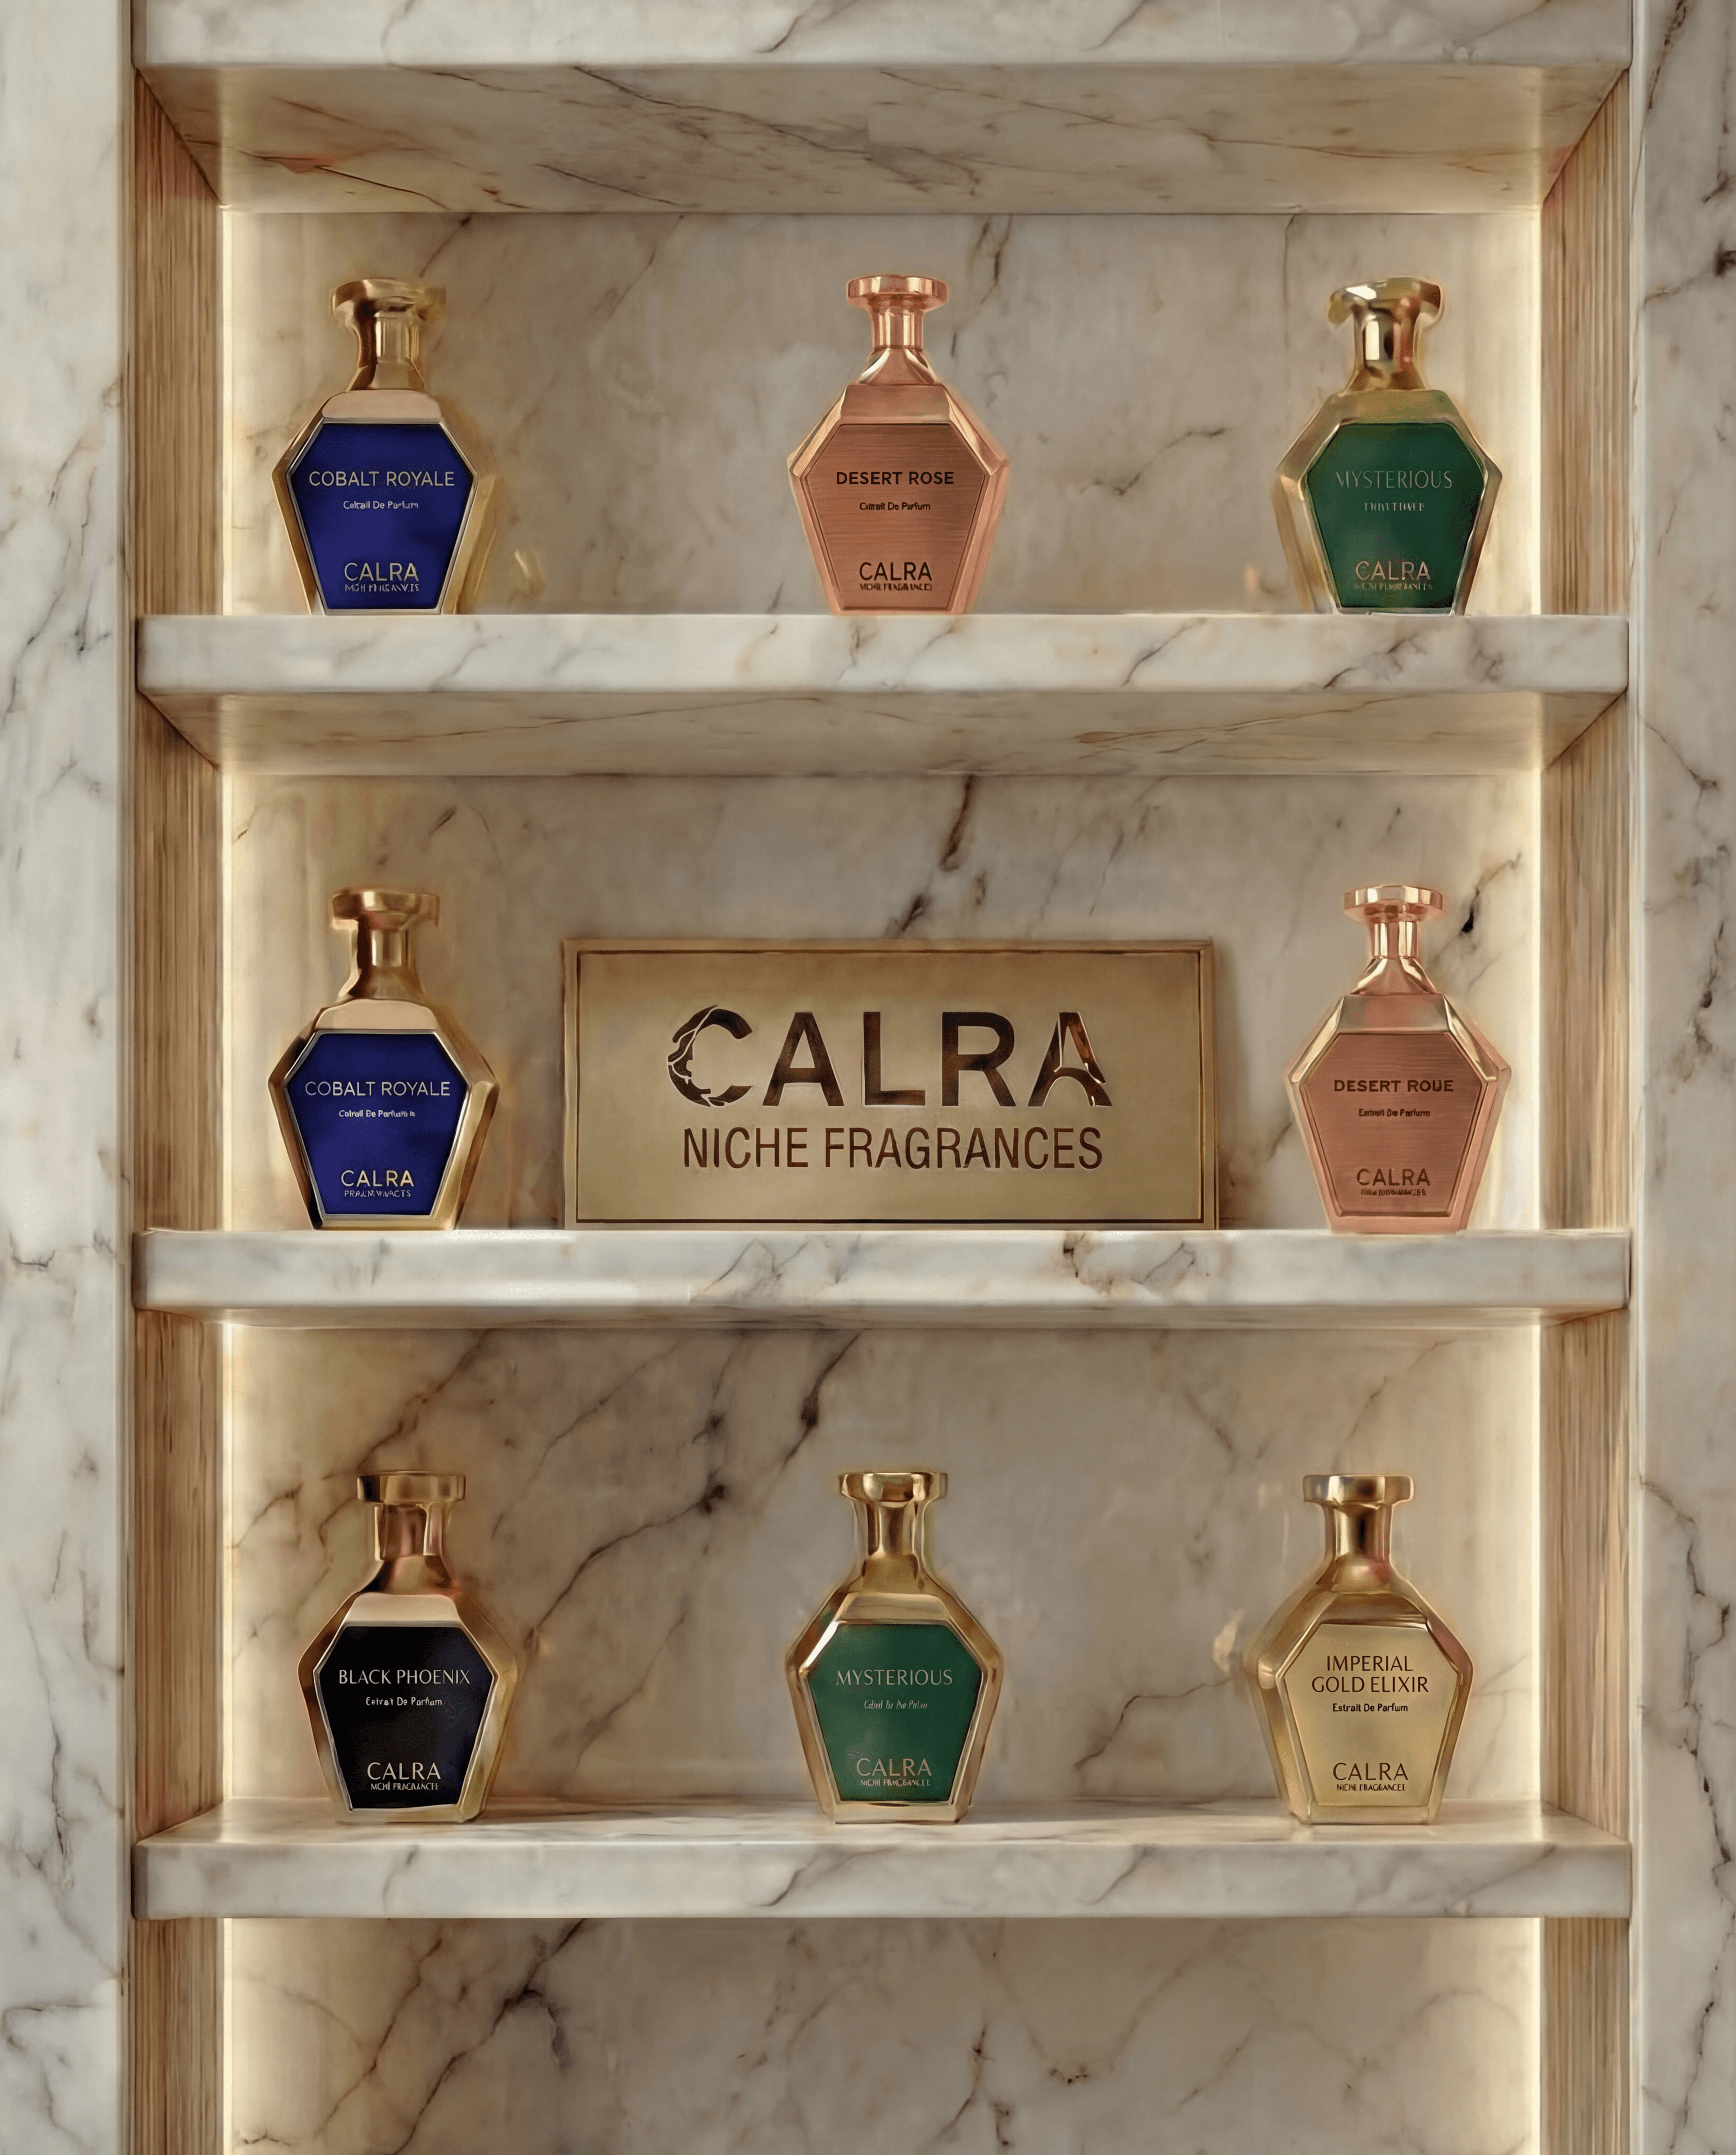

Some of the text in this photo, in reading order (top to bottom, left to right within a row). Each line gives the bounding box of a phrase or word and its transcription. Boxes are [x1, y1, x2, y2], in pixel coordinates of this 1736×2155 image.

[309, 471, 455, 486] COBALT ROYALE
[836, 471, 954, 485] DESERT ROSE
[1336, 470, 1452, 488] MYSTERIOUS
[373, 500, 385, 509] De
[344, 562, 420, 581] CALRA
[859, 562, 933, 581] CALRA
[1355, 561, 1432, 580] CALRA
[667, 1005, 1112, 1107] CALRA
[305, 1081, 450, 1096] COBALT ROYALE
[1334, 1080, 1401, 1092] DESERT
[683, 1128, 1103, 1169] NICHE FRAGRANCES
[340, 1170, 414, 1187] CALRA
[1356, 1168, 1431, 1186] CALRA
[1327, 1655, 1414, 1671] IMPERIAL
[339, 1670, 470, 1684] BLACK PHOENIX
[836, 1669, 953, 1685] MYSTERIOUS
[1311, 1676, 1429, 1692] GOLD ELIXIR
[397, 1697, 408, 1706] De
[1364, 1703, 1375, 1712] De
[367, 1762, 441, 1780] CALRA
[856, 1757, 932, 1777] CALRA
[1332, 1762, 1409, 1781] CALRA
